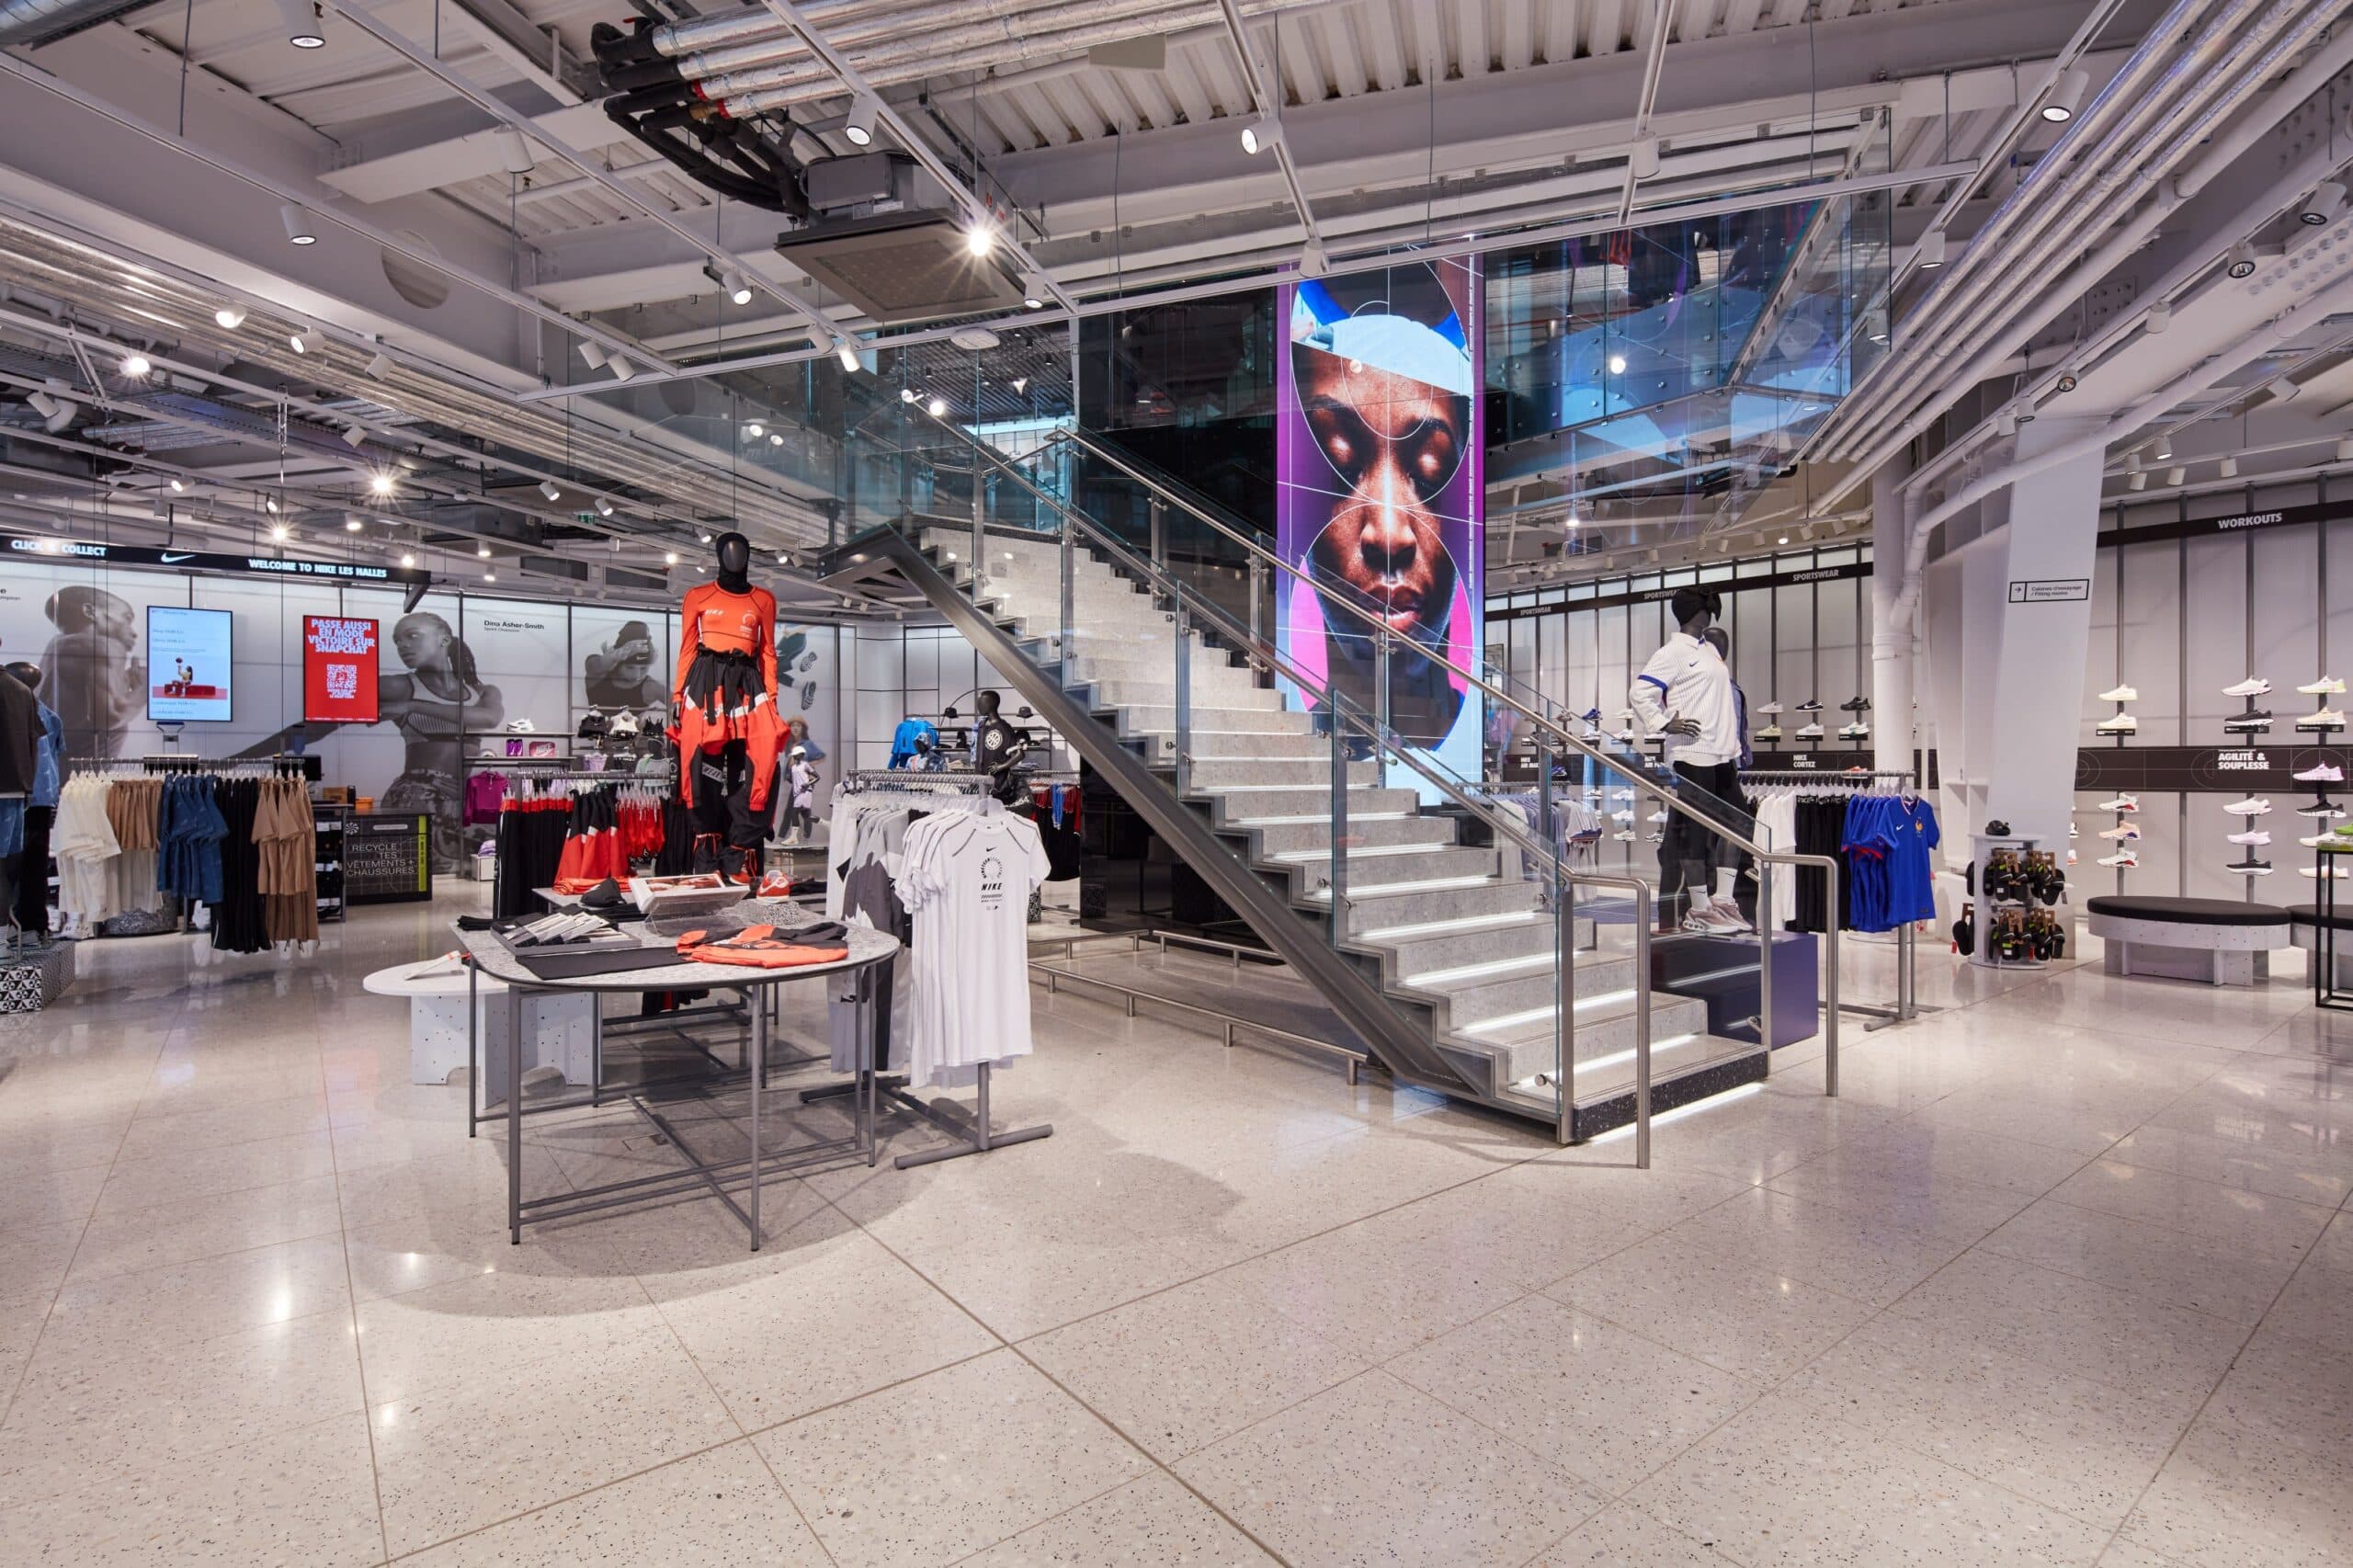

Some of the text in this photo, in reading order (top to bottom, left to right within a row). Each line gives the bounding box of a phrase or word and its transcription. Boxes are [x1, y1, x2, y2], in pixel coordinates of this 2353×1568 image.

[2218, 513, 2282, 529] WORKOUTS
[11, 540, 42, 551] CLICK
[62, 544, 107, 556] COLLECT
[248, 559, 387, 578] WELCOME TO NIKE LES HALLES
[1792, 569, 1839, 582] SPORTSWEAR
[1520, 607, 1552, 617] SPORTSWEAR
[311, 619, 371, 631] PASSE AUSSI
[318, 628, 365, 638] EN MODE
[308, 634, 375, 647] VICTOIRE SUR
[315, 643, 368, 654] SNAPCHAT
[2218, 751, 2266, 761] AGILITÉ &
[2218, 761, 2269, 770] SOUPLESSE
[352, 843, 397, 852] RECYCLE
[380, 851, 397, 859] TES
[347, 858, 406, 869] VÊTEMENTS
[347, 867, 415, 876] CHAUSSURES
[981, 882, 1003, 891] NIKE
